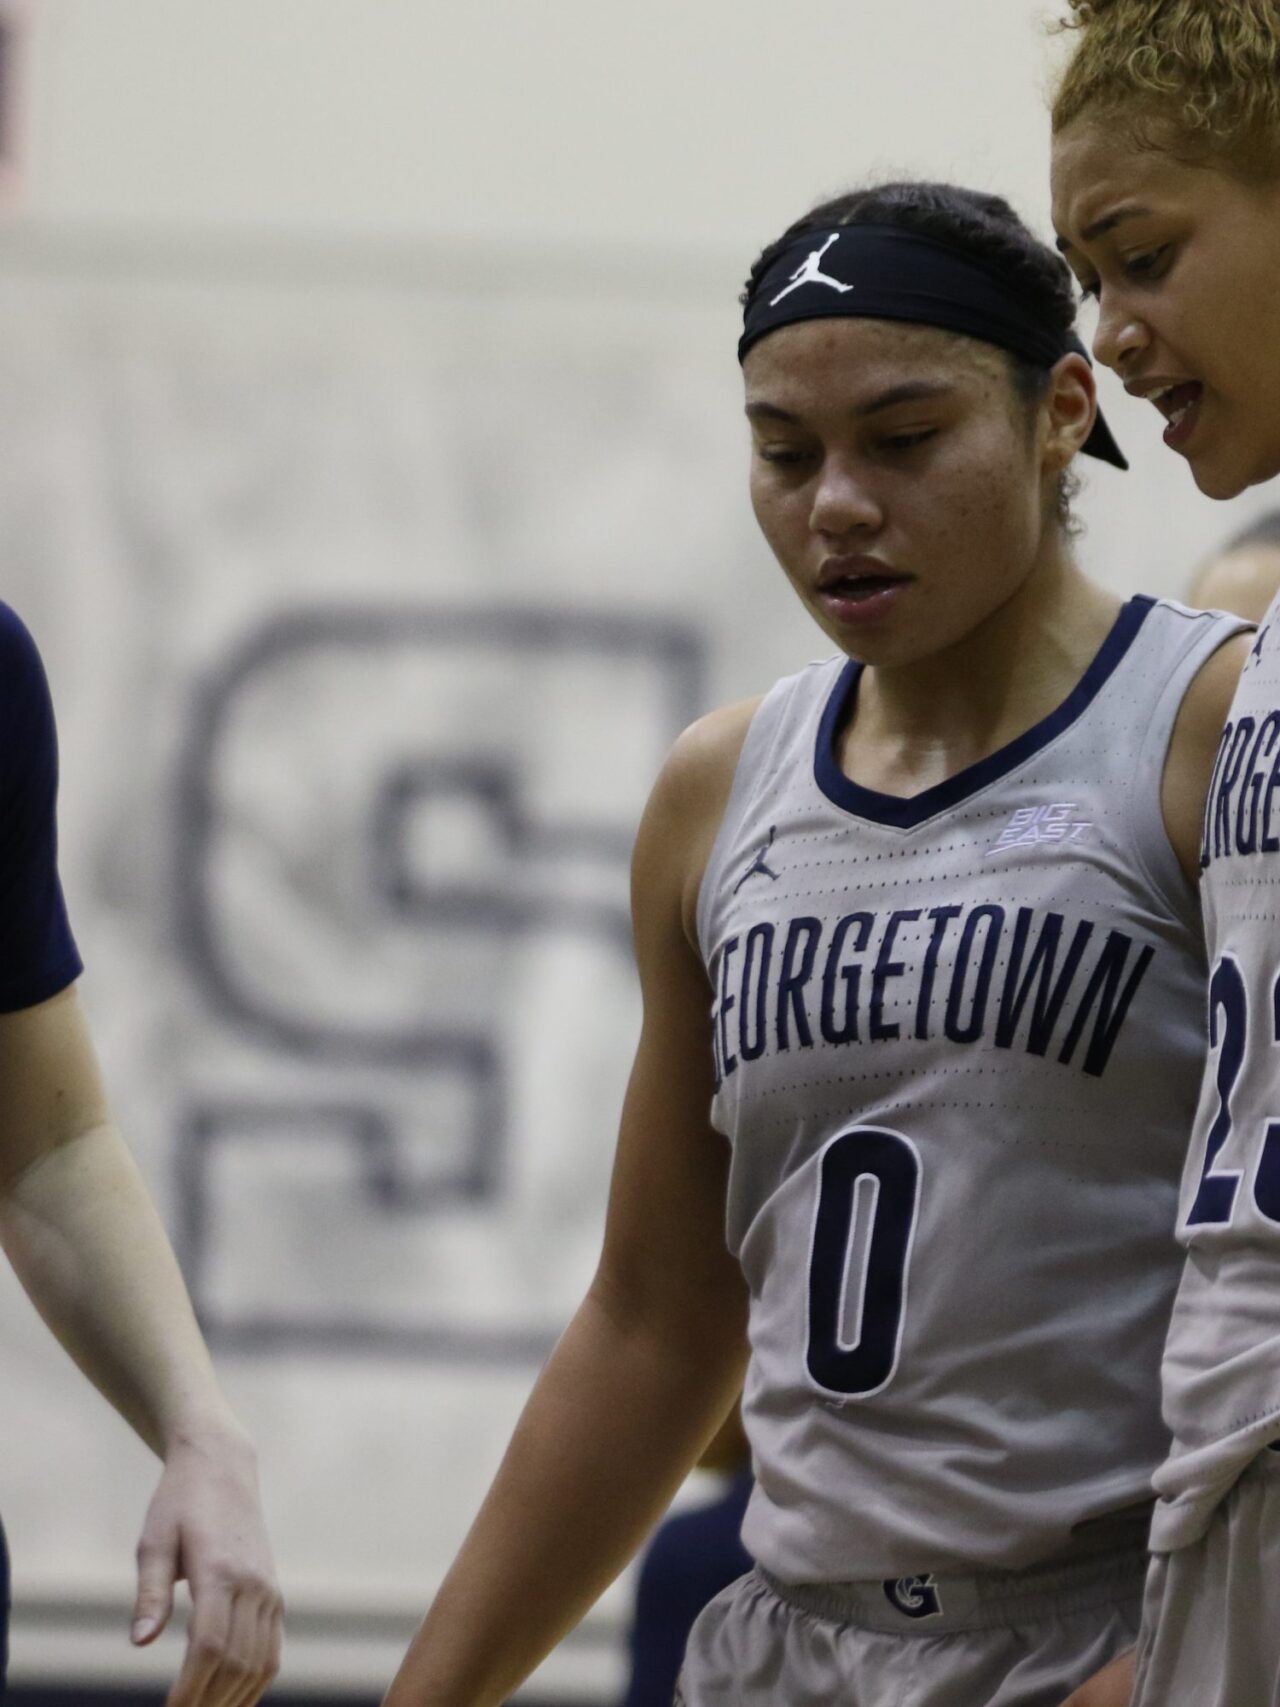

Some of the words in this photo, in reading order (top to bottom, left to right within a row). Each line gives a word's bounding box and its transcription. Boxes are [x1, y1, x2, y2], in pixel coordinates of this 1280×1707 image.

[995, 822, 1094, 845] EAST
[1008, 803, 1077, 826] BIG
[714, 905, 1155, 1093] EORGETOWN
[804, 1125, 922, 1398] 0
